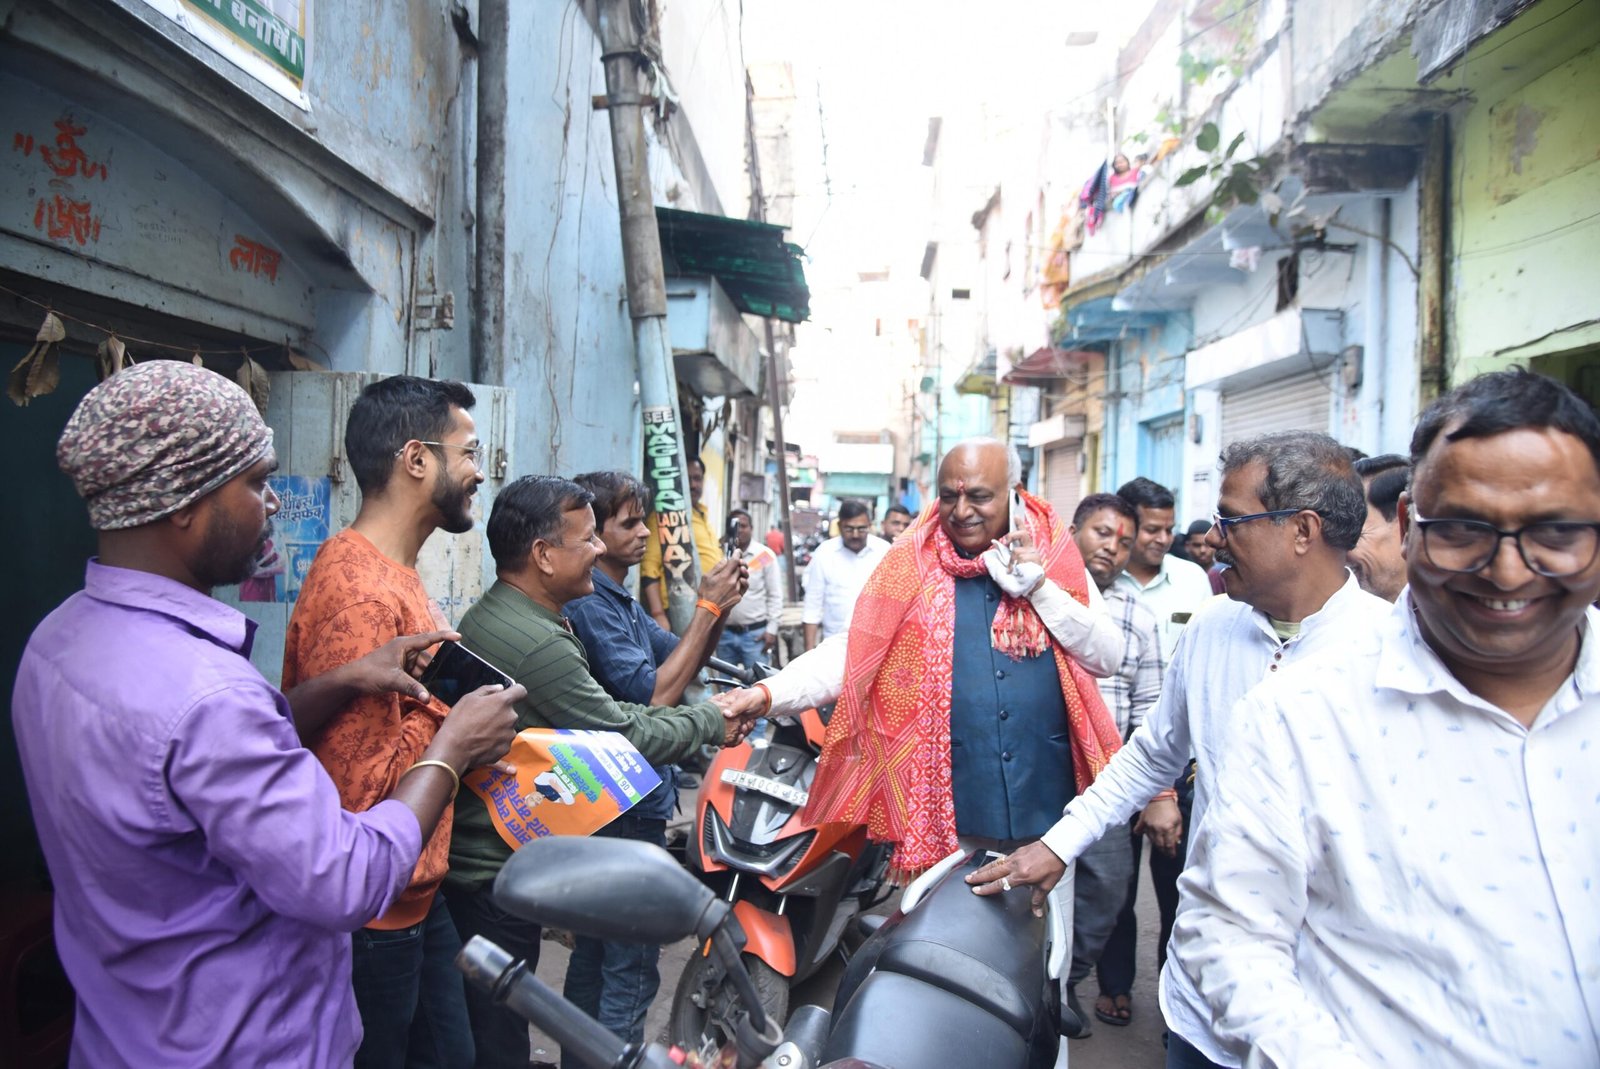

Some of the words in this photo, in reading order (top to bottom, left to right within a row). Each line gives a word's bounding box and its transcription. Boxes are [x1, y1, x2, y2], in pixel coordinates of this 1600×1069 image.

[643, 409, 674, 424] SEE
[645, 422, 686, 513] MAGICIAN
[656, 511, 687, 527] LADY
[527, 817, 554, 839] रादे
